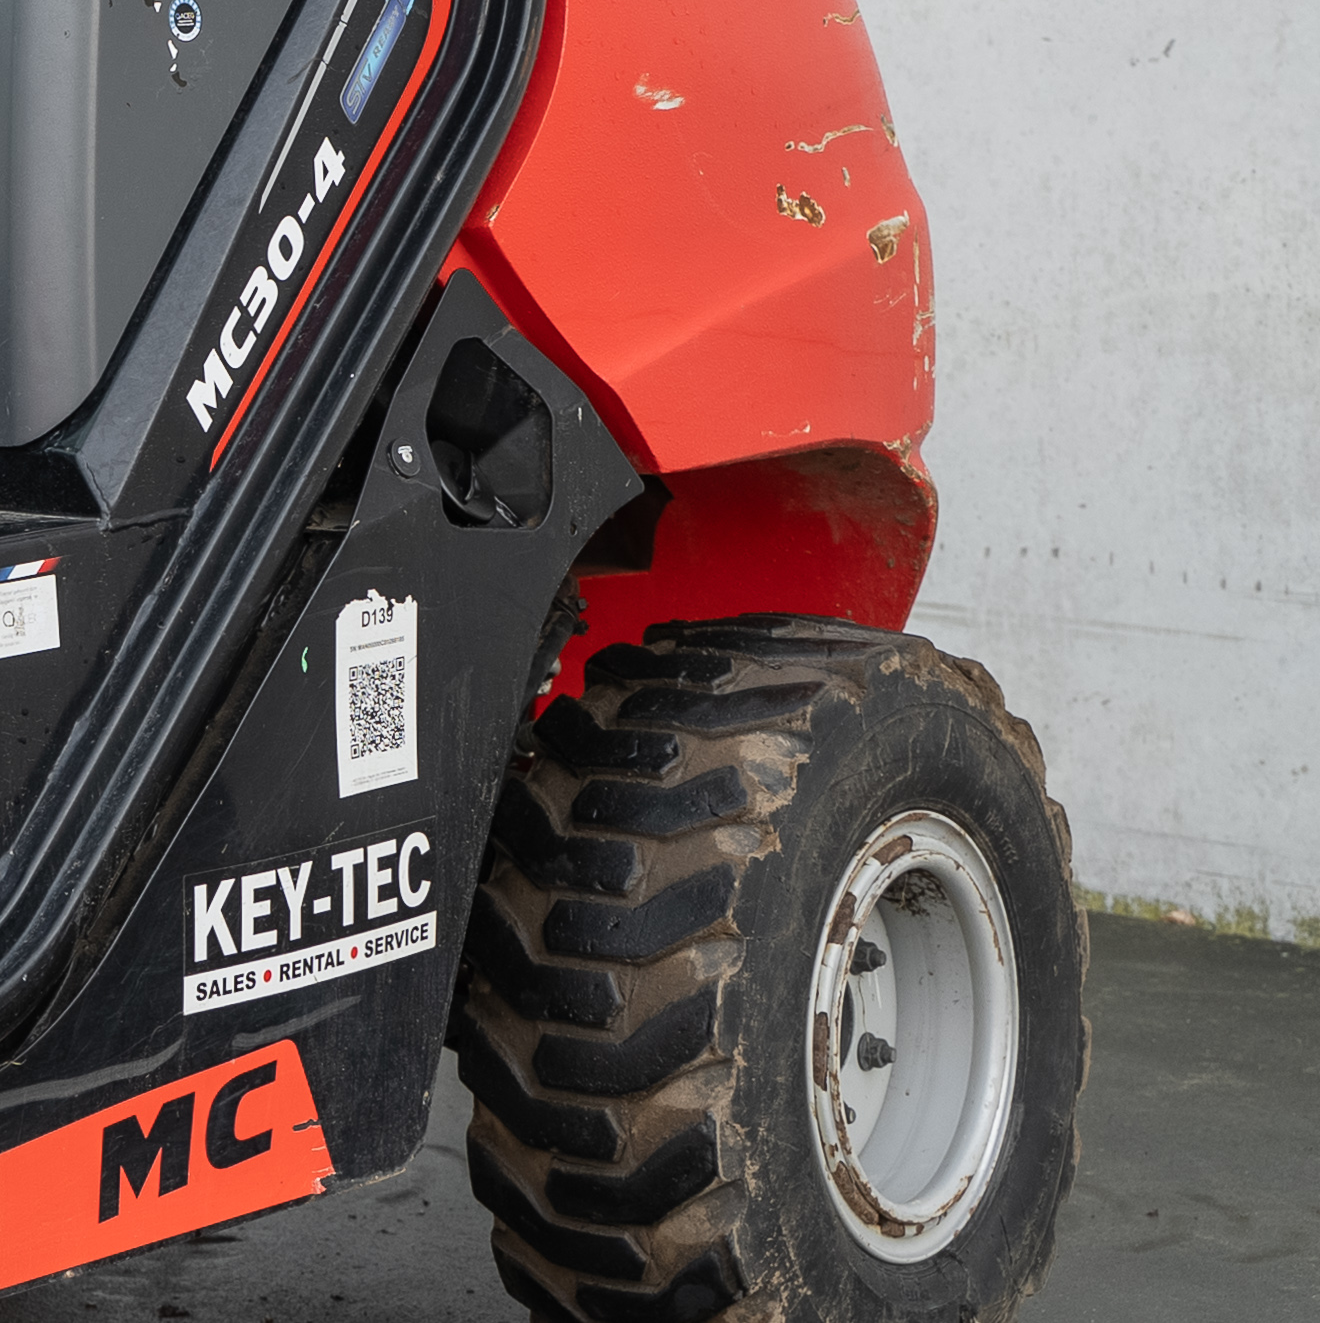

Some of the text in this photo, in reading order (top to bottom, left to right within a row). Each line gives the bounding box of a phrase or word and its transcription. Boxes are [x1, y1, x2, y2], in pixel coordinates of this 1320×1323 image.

[185, 136, 347, 433] MC30-4
[360, 607, 394, 628] D139
[193, 831, 432, 963] KEY-TEC
[196, 921, 430, 1003] SALES RENTAL SERVICE
[98, 1060, 279, 1224] MC
